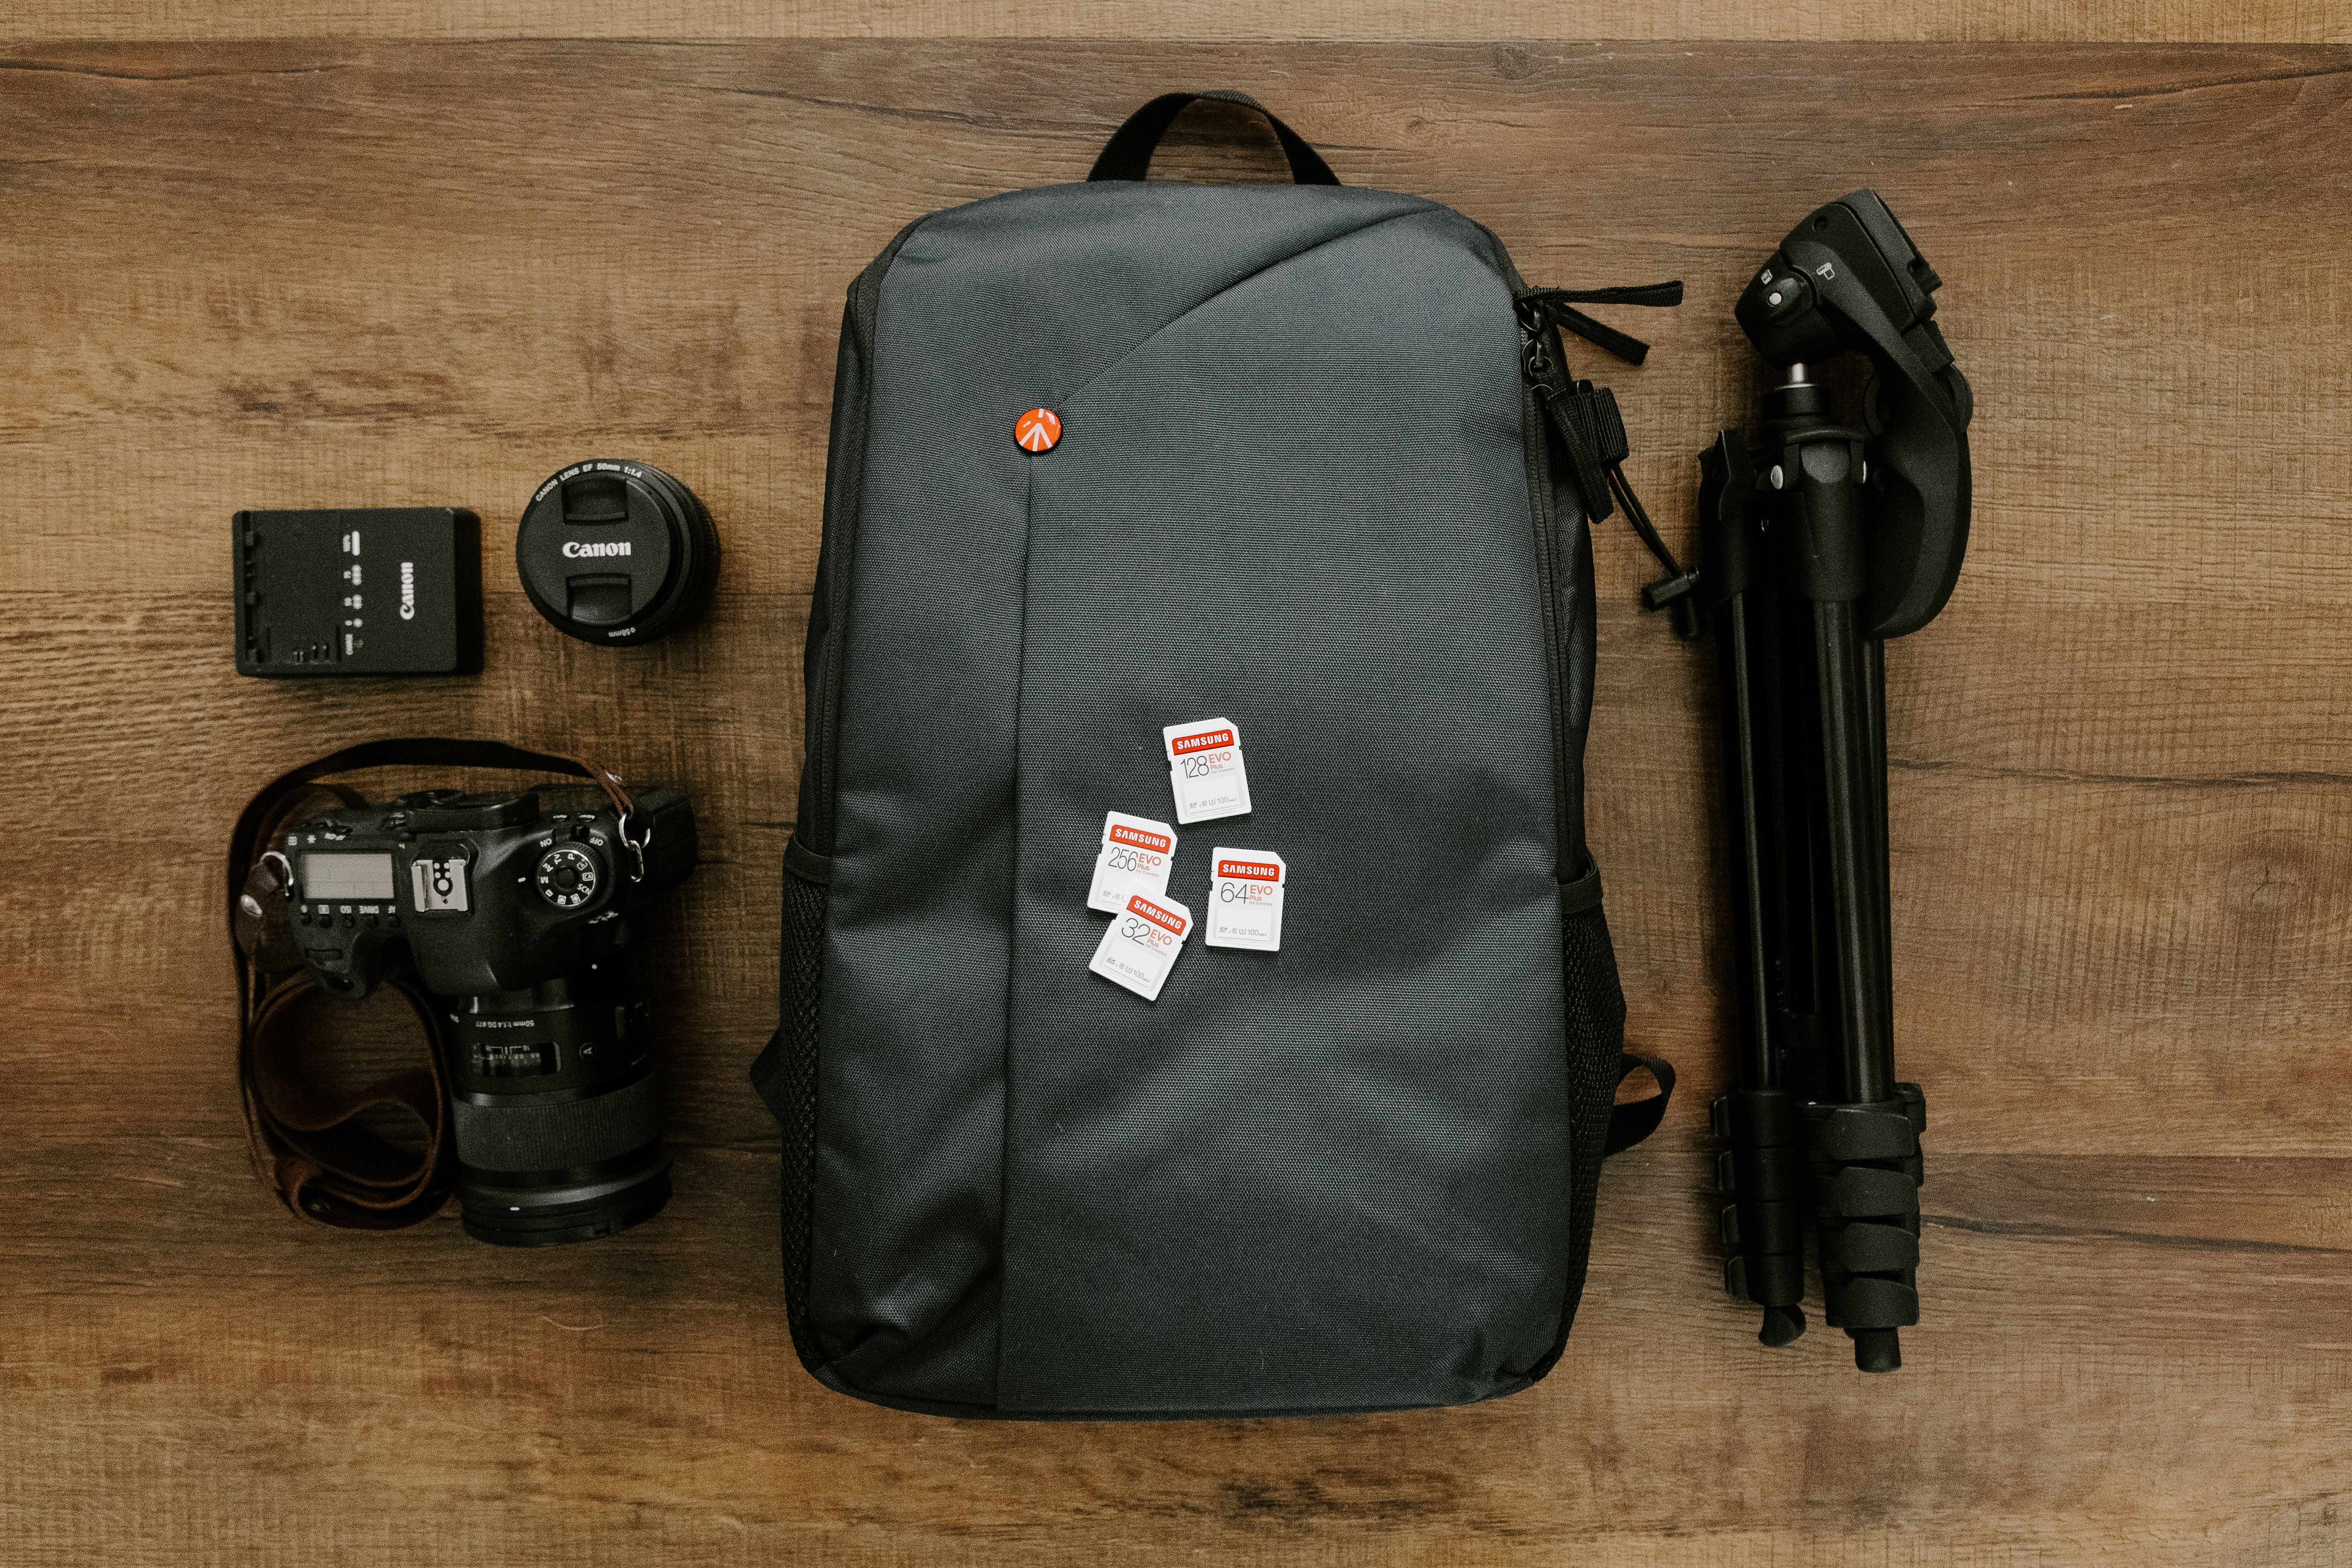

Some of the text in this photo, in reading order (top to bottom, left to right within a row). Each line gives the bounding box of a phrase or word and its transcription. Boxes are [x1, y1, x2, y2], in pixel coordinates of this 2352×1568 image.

[535, 463, 642, 502] CANON LENS EF 50mm 1:1.4
[562, 541, 632, 558] Canon
[399, 562, 415, 620] Canon
[1177, 733, 1229, 750] SAMSUNG
[1208, 751, 1231, 764] EVO
[1181, 755, 1209, 779] 128
[540, 838, 552, 847] ON
[589, 837, 603, 846] OFF
[1115, 828, 1166, 848] SAMSUNG
[1108, 847, 1138, 871] 256
[1138, 853, 1162, 866] EVO
[1223, 864, 1275, 876] SAMSUNG
[577, 883, 592, 895] SCN
[1221, 882, 1249, 904] 64
[1250, 884, 1273, 895] EVO
[1133, 900, 1182, 929] SAMSUNG
[1122, 918, 1151, 945] 32
[1150, 928, 1172, 945] EVO
[1147, 938, 1159, 948] Plus
[1152, 947, 1167, 957] Creators
[1133, 970, 1144, 979] 100
